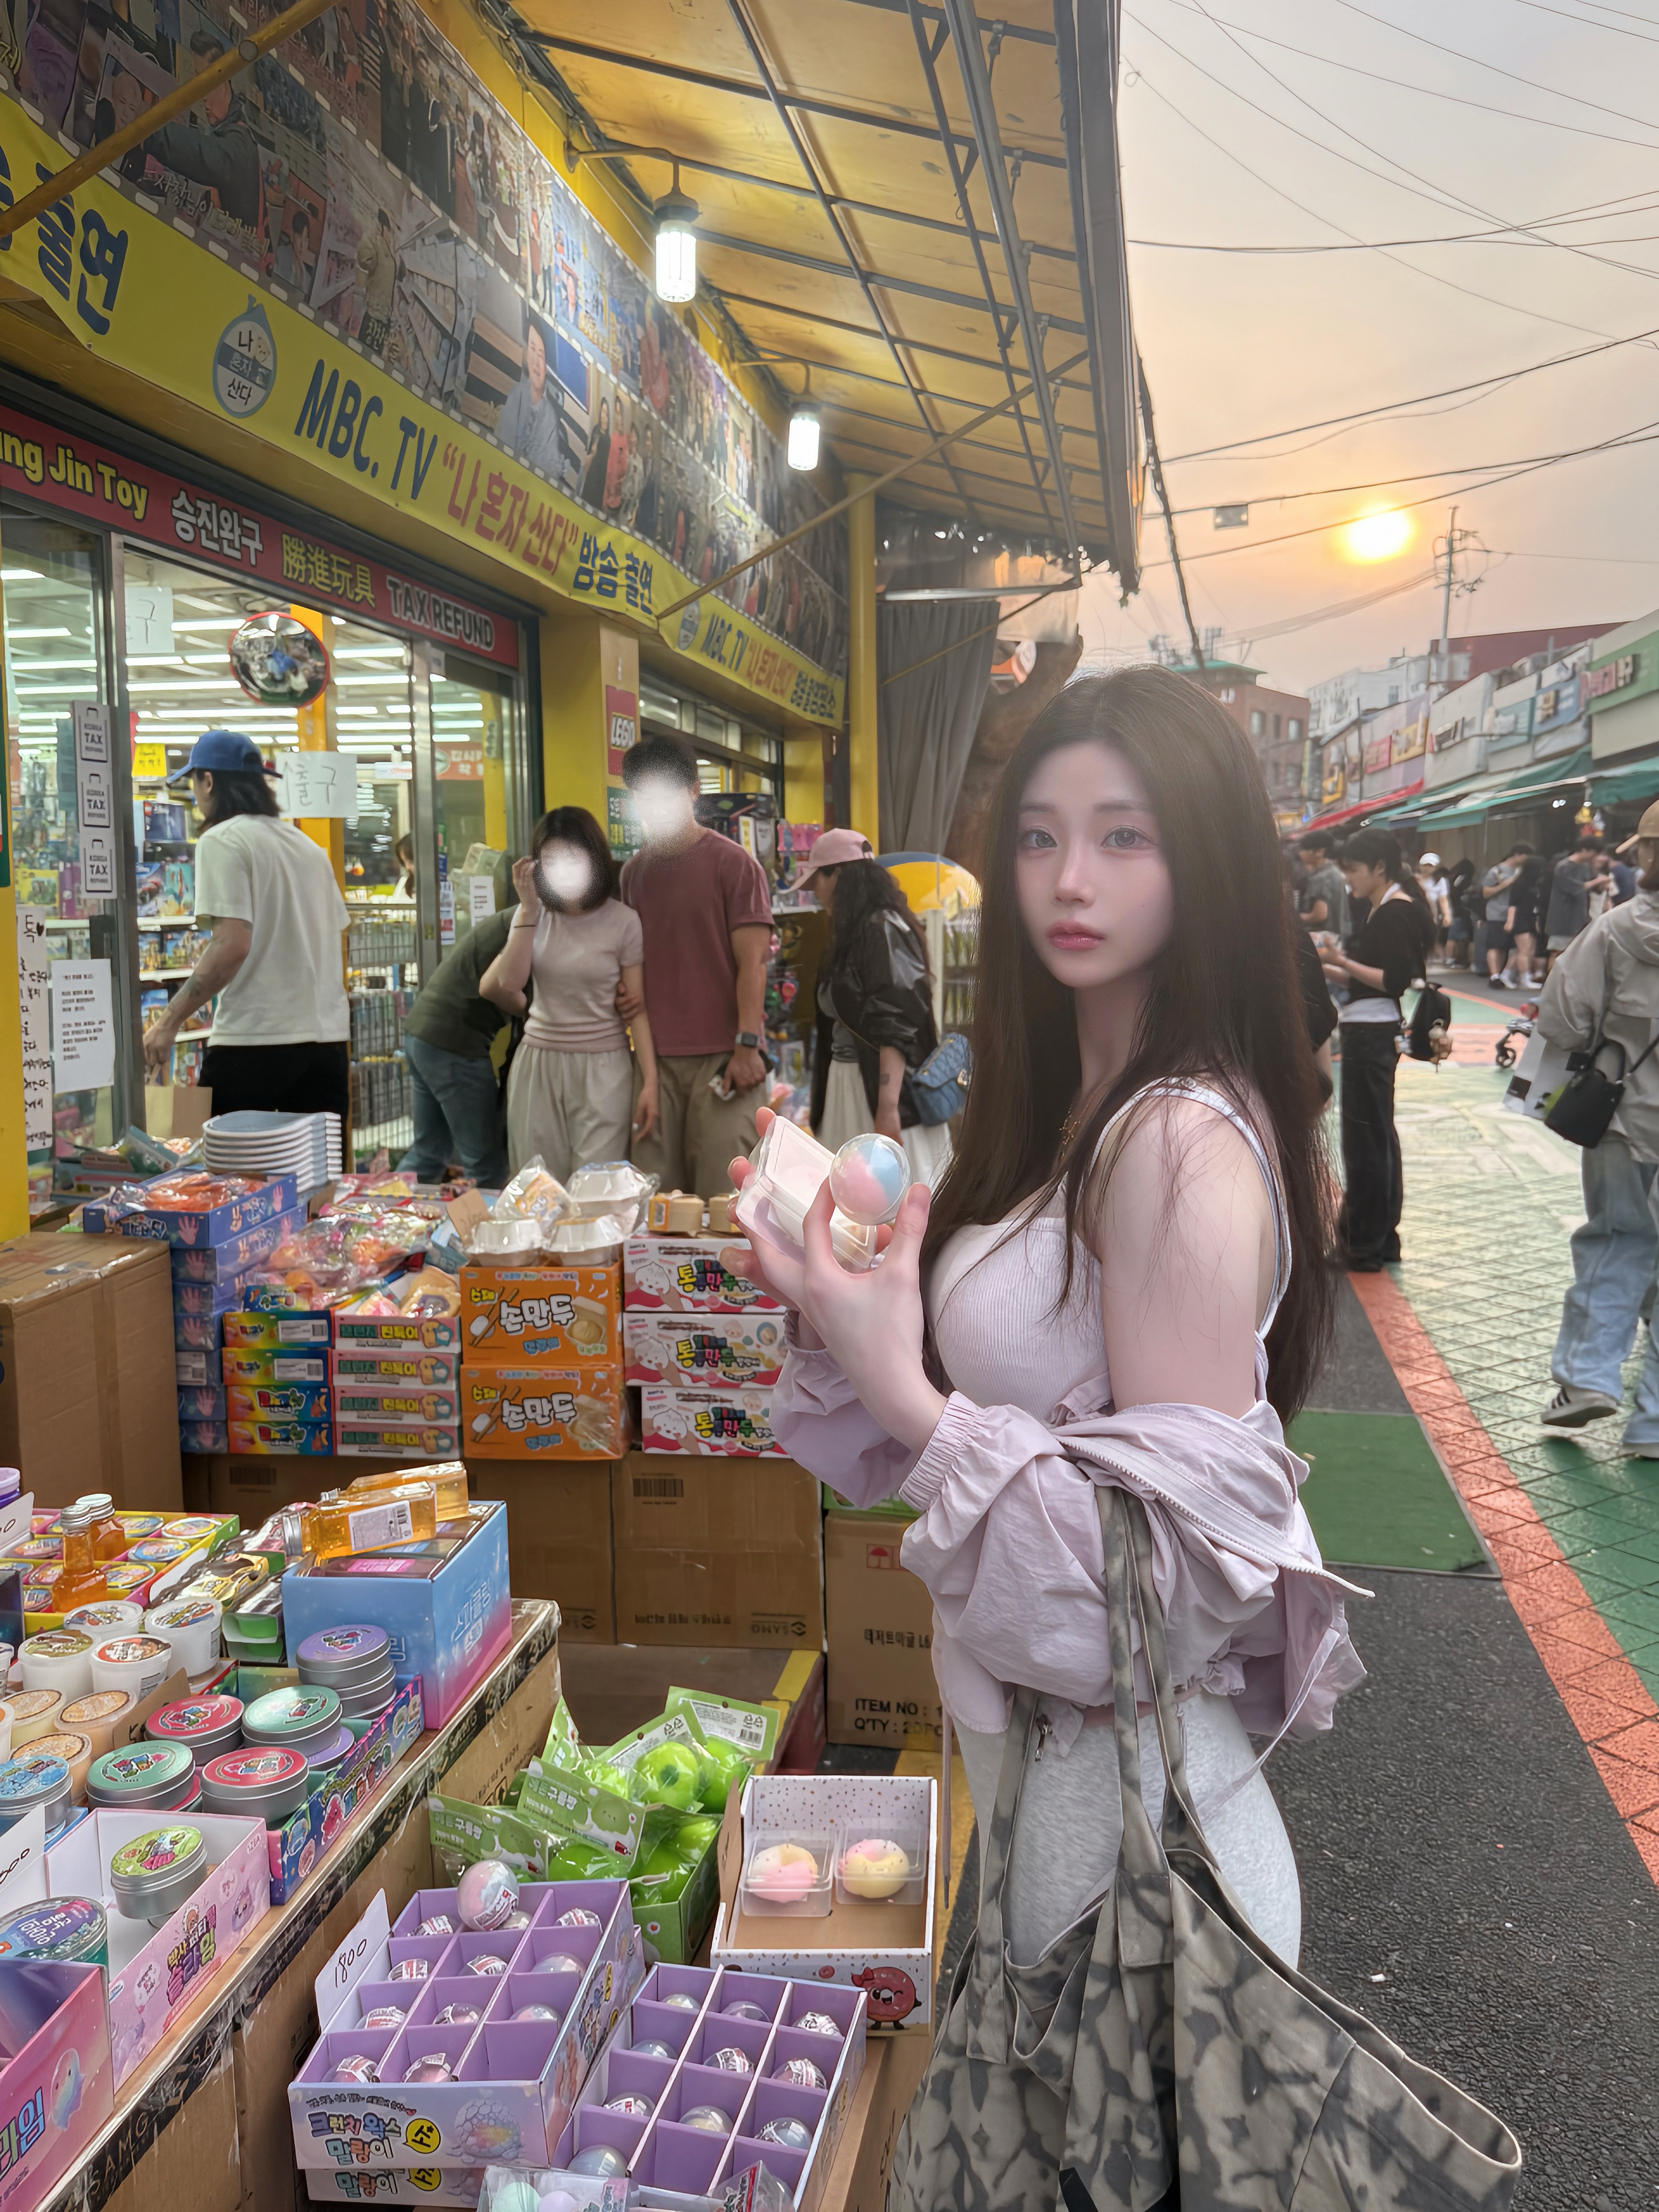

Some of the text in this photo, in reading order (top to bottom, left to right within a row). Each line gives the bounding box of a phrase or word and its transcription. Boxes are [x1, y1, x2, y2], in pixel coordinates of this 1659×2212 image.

[238, 330, 254, 352] 나
[227, 377, 252, 406] 산다
[49, 446, 93, 493] Jin
[97, 462, 148, 520] Toy
[294, 359, 383, 479] MBC.
[391, 415, 439, 501] TV
[475, 472, 530, 553] 혼자
[573, 531, 619, 599] 방송
[625, 551, 653, 616] 출연
[171, 489, 264, 567] 승진완구
[282, 534, 375, 609] 勝進玩具
[387, 578, 494, 651] TAX REFUND
[85, 732, 103, 745] TAX
[87, 799, 105, 810] TAX
[90, 865, 108, 875] TAX
[500, 1293, 576, 1334] 손만두
[501, 1392, 577, 1430] 손만두
[855, 1698, 891, 1713] ITEM
[896, 1702, 918, 1715] NO
[167, 1927, 215, 2006] 슬라임
[334, 1938, 367, 1989] 1800
[308, 2111, 402, 2139] 크런치 왁스
[87, 2112, 149, 2195] SAMG
[325, 2136, 394, 2166] 말랑이
[335, 2171, 398, 2198] 말랑이
